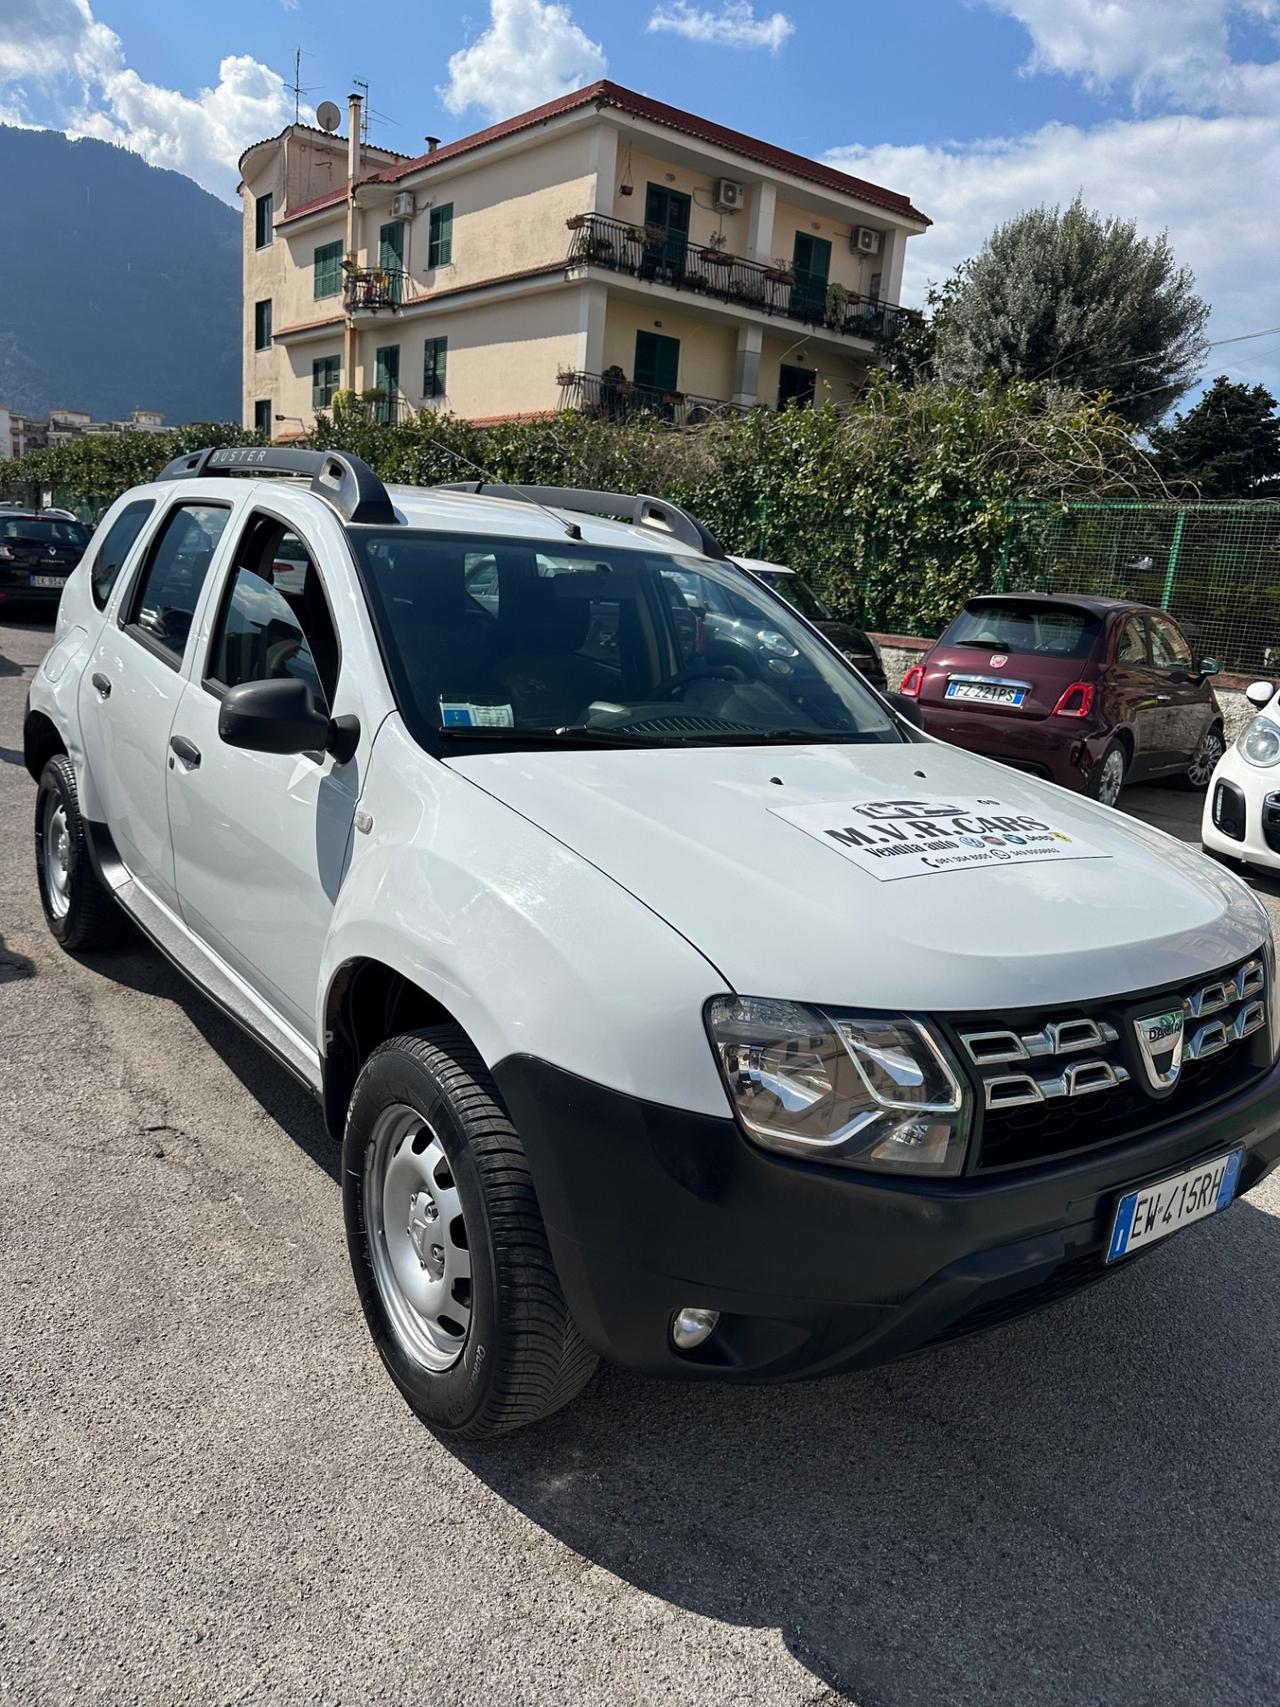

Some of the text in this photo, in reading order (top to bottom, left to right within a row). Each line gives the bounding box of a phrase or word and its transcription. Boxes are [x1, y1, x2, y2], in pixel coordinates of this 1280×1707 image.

[211, 450, 267, 464] DUSTER
[956, 684, 974, 697] FZ
[975, 685, 1015, 702] 221PS
[863, 843, 927, 858] Vendita
[923, 840, 959, 852] auto
[1149, 1023, 1182, 1041] DACIA
[1131, 1191, 1161, 1240] EW
[1162, 1165, 1226, 1225] 415RH
